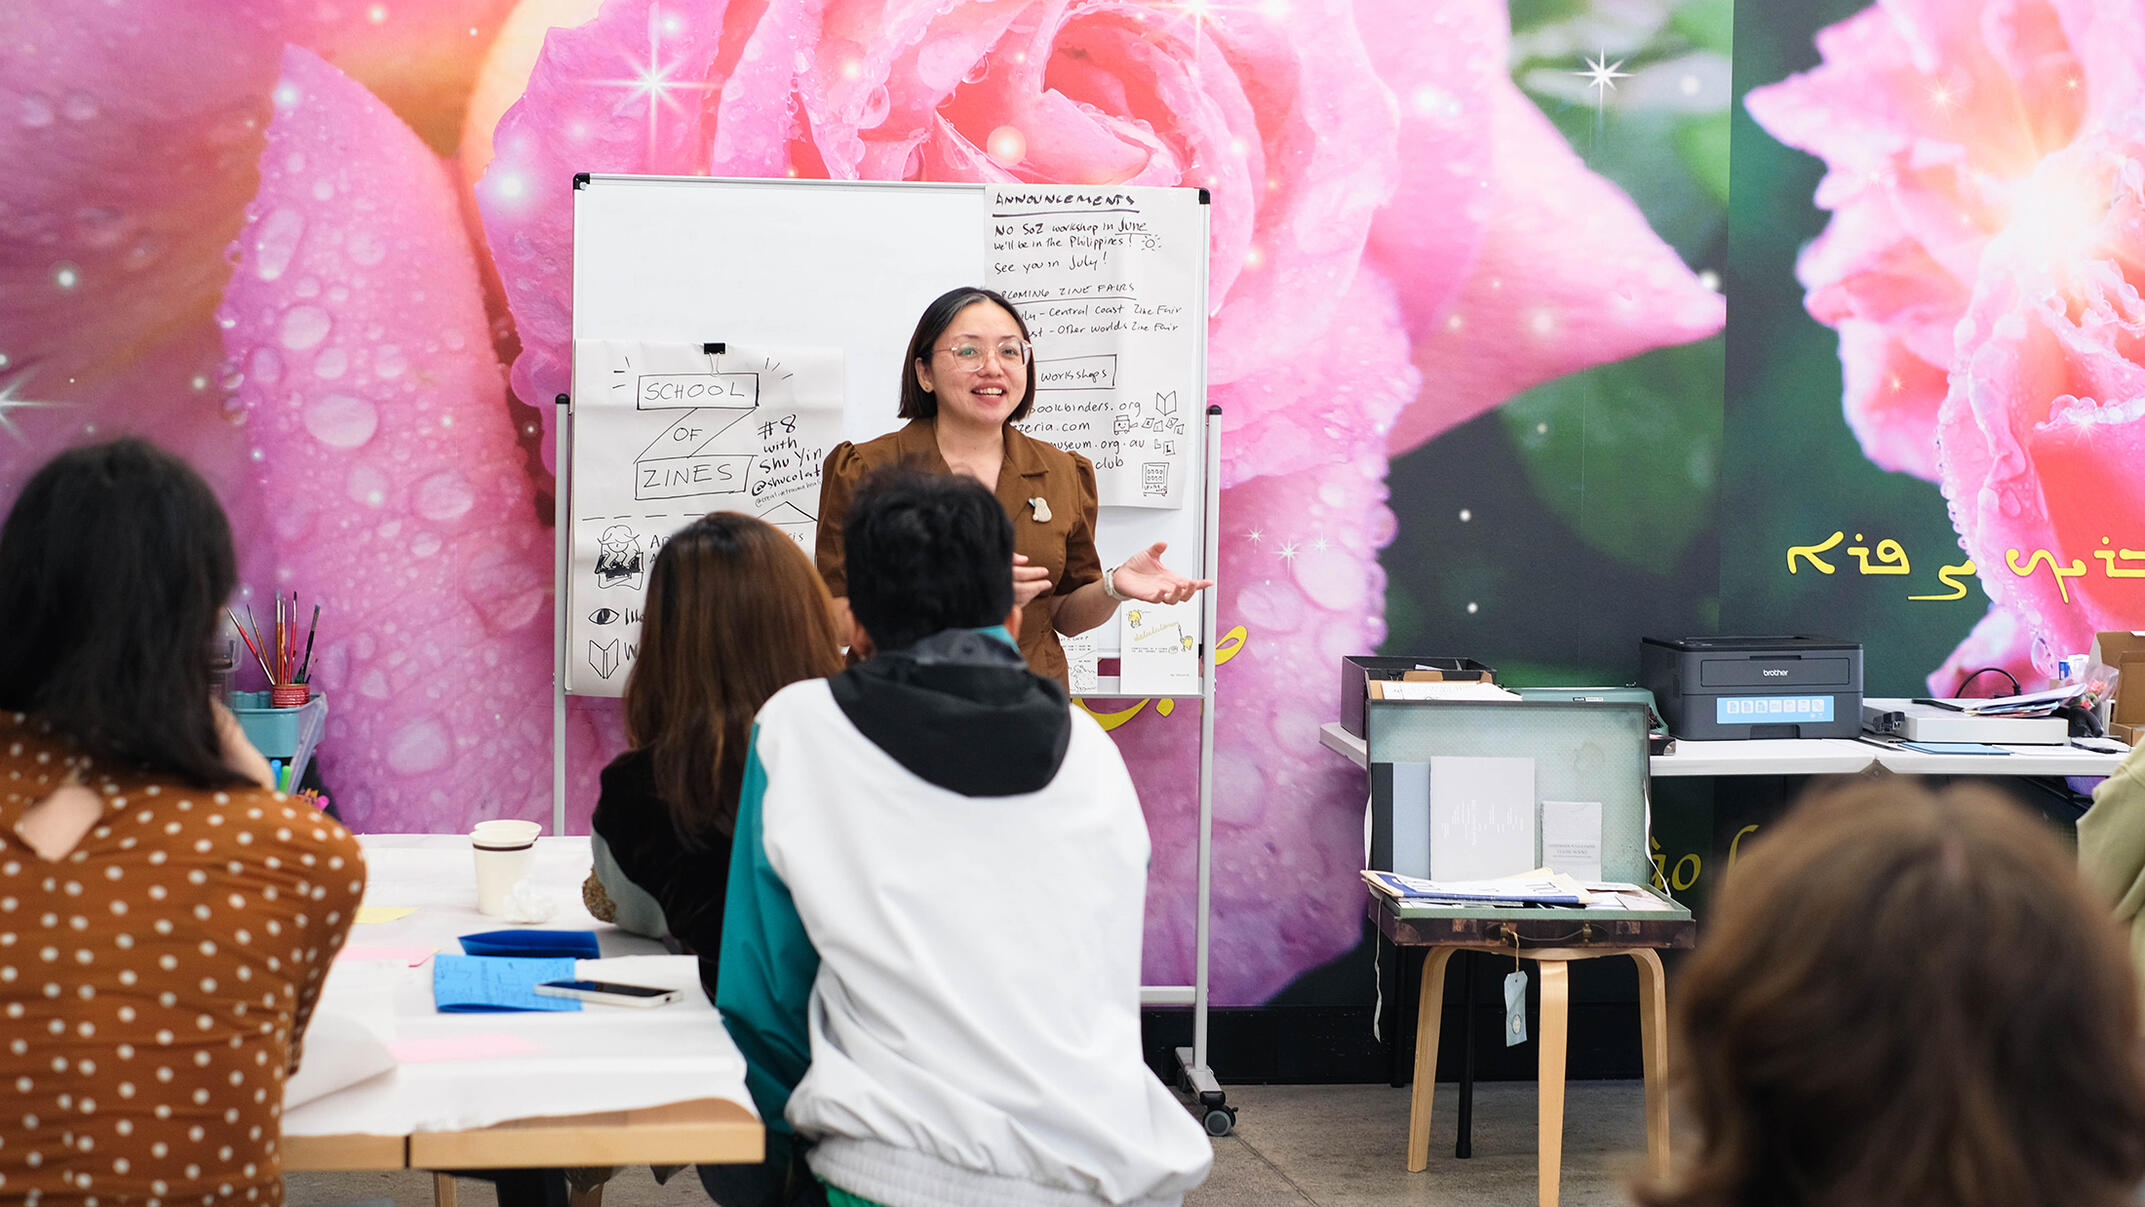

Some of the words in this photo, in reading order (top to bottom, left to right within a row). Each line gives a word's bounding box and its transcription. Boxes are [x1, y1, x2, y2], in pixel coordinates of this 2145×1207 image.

[995, 192, 1136, 206] ANNOUNCEMENTS
[1051, 222, 1099, 236] workshop
[1102, 222, 1114, 231] in
[1118, 217, 1148, 233] June
[1017, 239, 1029, 249] be
[1031, 239, 1042, 248] in
[1046, 236, 1062, 248] the
[1022, 261, 1045, 274] you
[1047, 260, 1060, 268] in
[1000, 288, 1050, 300] PCOMING
[1059, 285, 1092, 296] ZINE
[1098, 282, 1135, 294] FAIRS
[1021, 310, 1036, 321] ly
[1048, 304, 1089, 317] Central
[1094, 304, 1125, 315] Coast
[1133, 303, 1154, 316] Zine
[1156, 304, 1183, 315] Fair
[1057, 323, 1086, 335] Other
[1131, 321, 1150, 332] Zine
[1154, 322, 1179, 332] Fair
[644, 381, 746, 401] SCHOOL
[673, 427, 704, 442] OF
[763, 436, 797, 453] with
[759, 457, 790, 474] Shu
[794, 447, 822, 468] Yin
[1095, 456, 1124, 470] club
[642, 463, 734, 489] ZINES
[1762, 664, 1789, 676] brother
